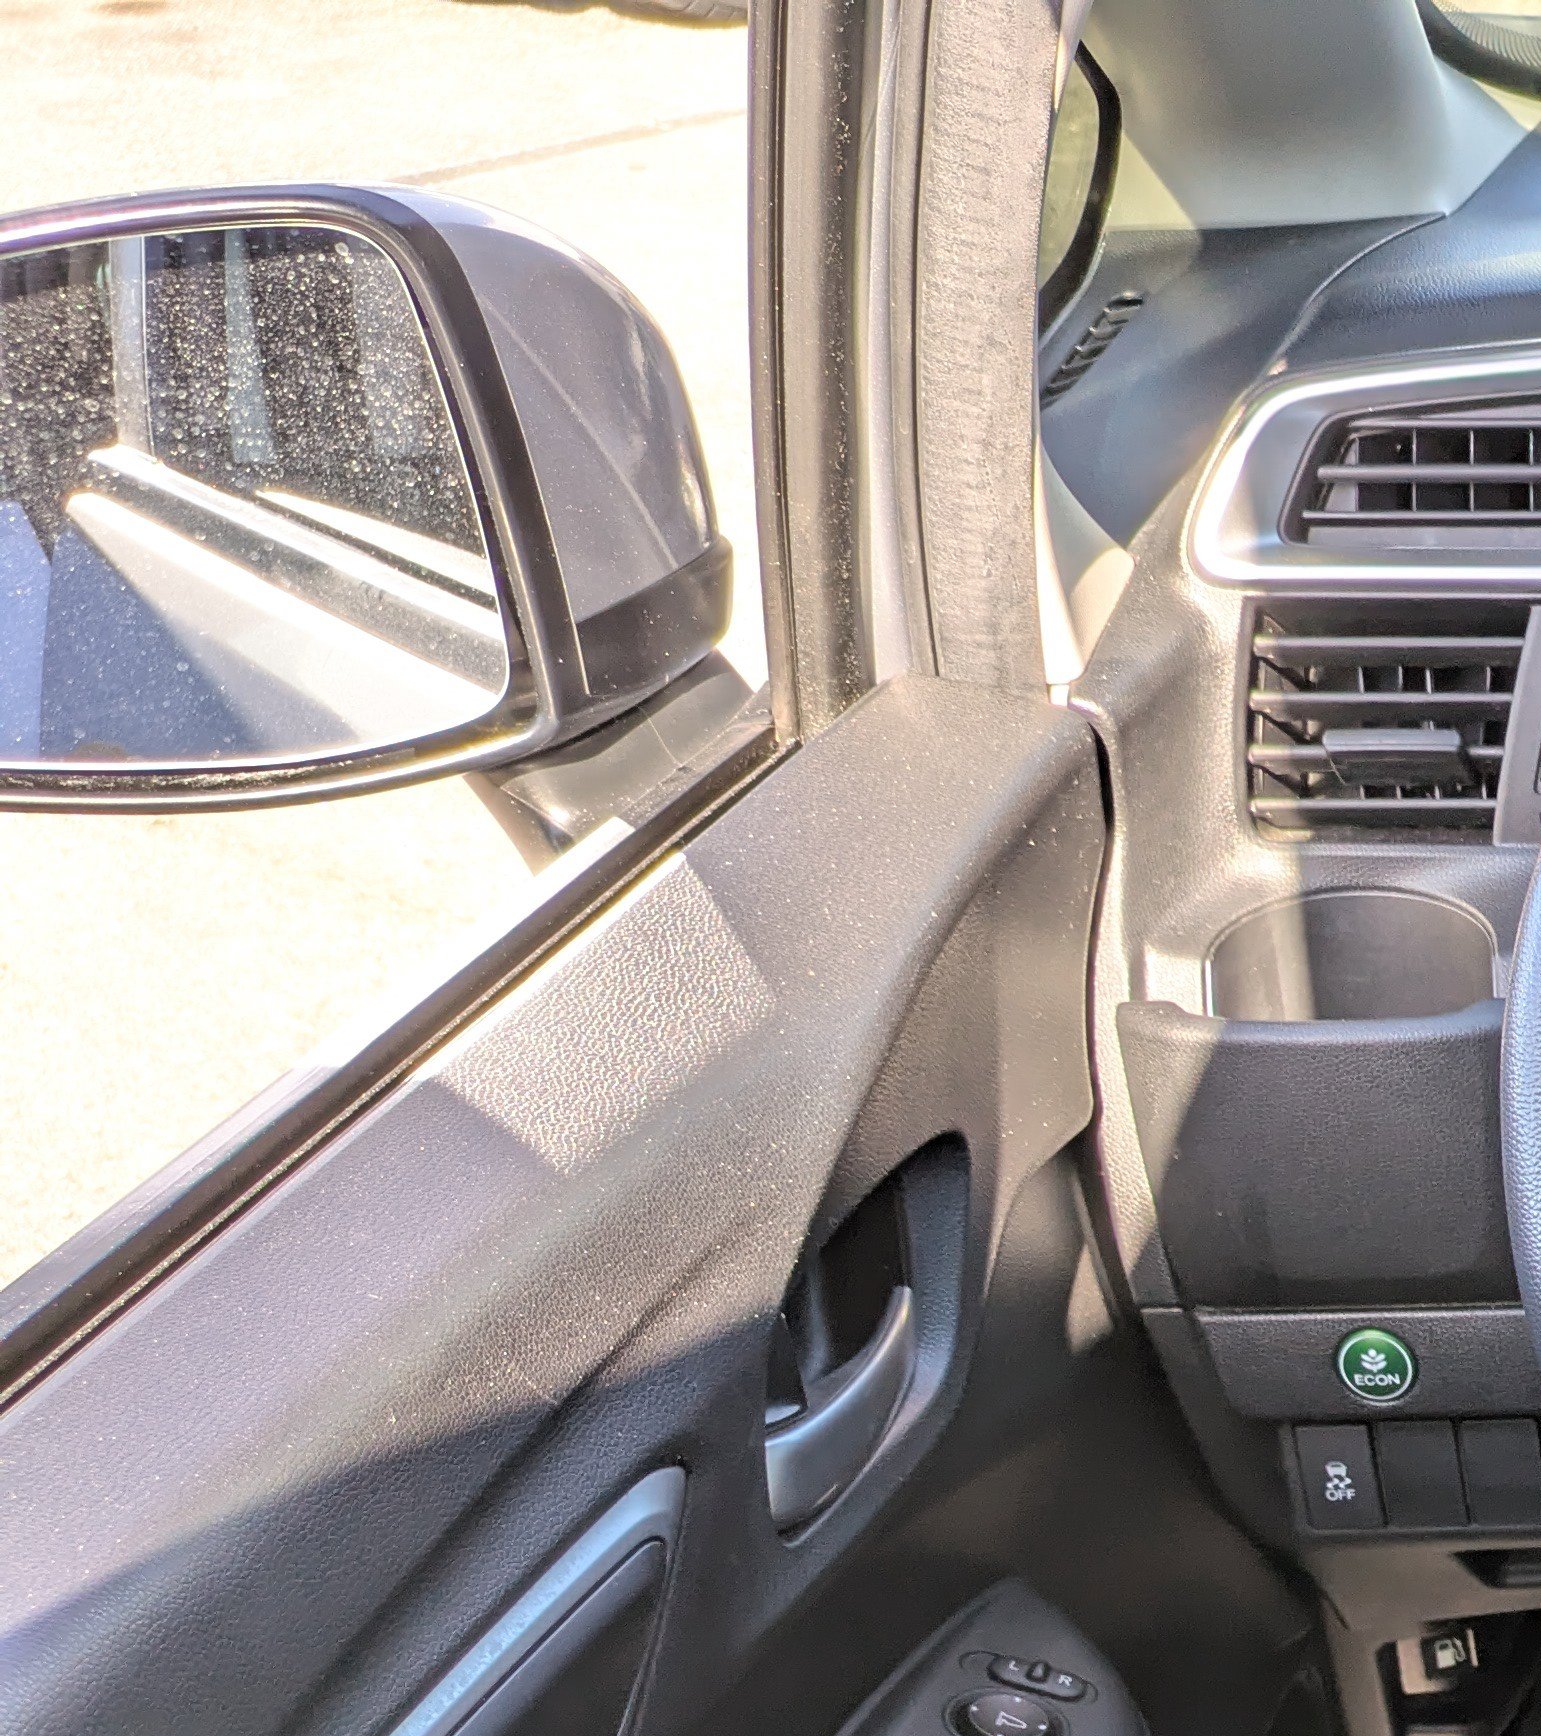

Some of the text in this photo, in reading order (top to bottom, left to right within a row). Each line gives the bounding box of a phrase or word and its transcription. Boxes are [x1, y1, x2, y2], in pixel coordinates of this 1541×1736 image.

[1354, 1373, 1401, 1386] ECON
[1324, 1489, 1355, 1501] OFF
[1058, 1674, 1072, 1687] R
